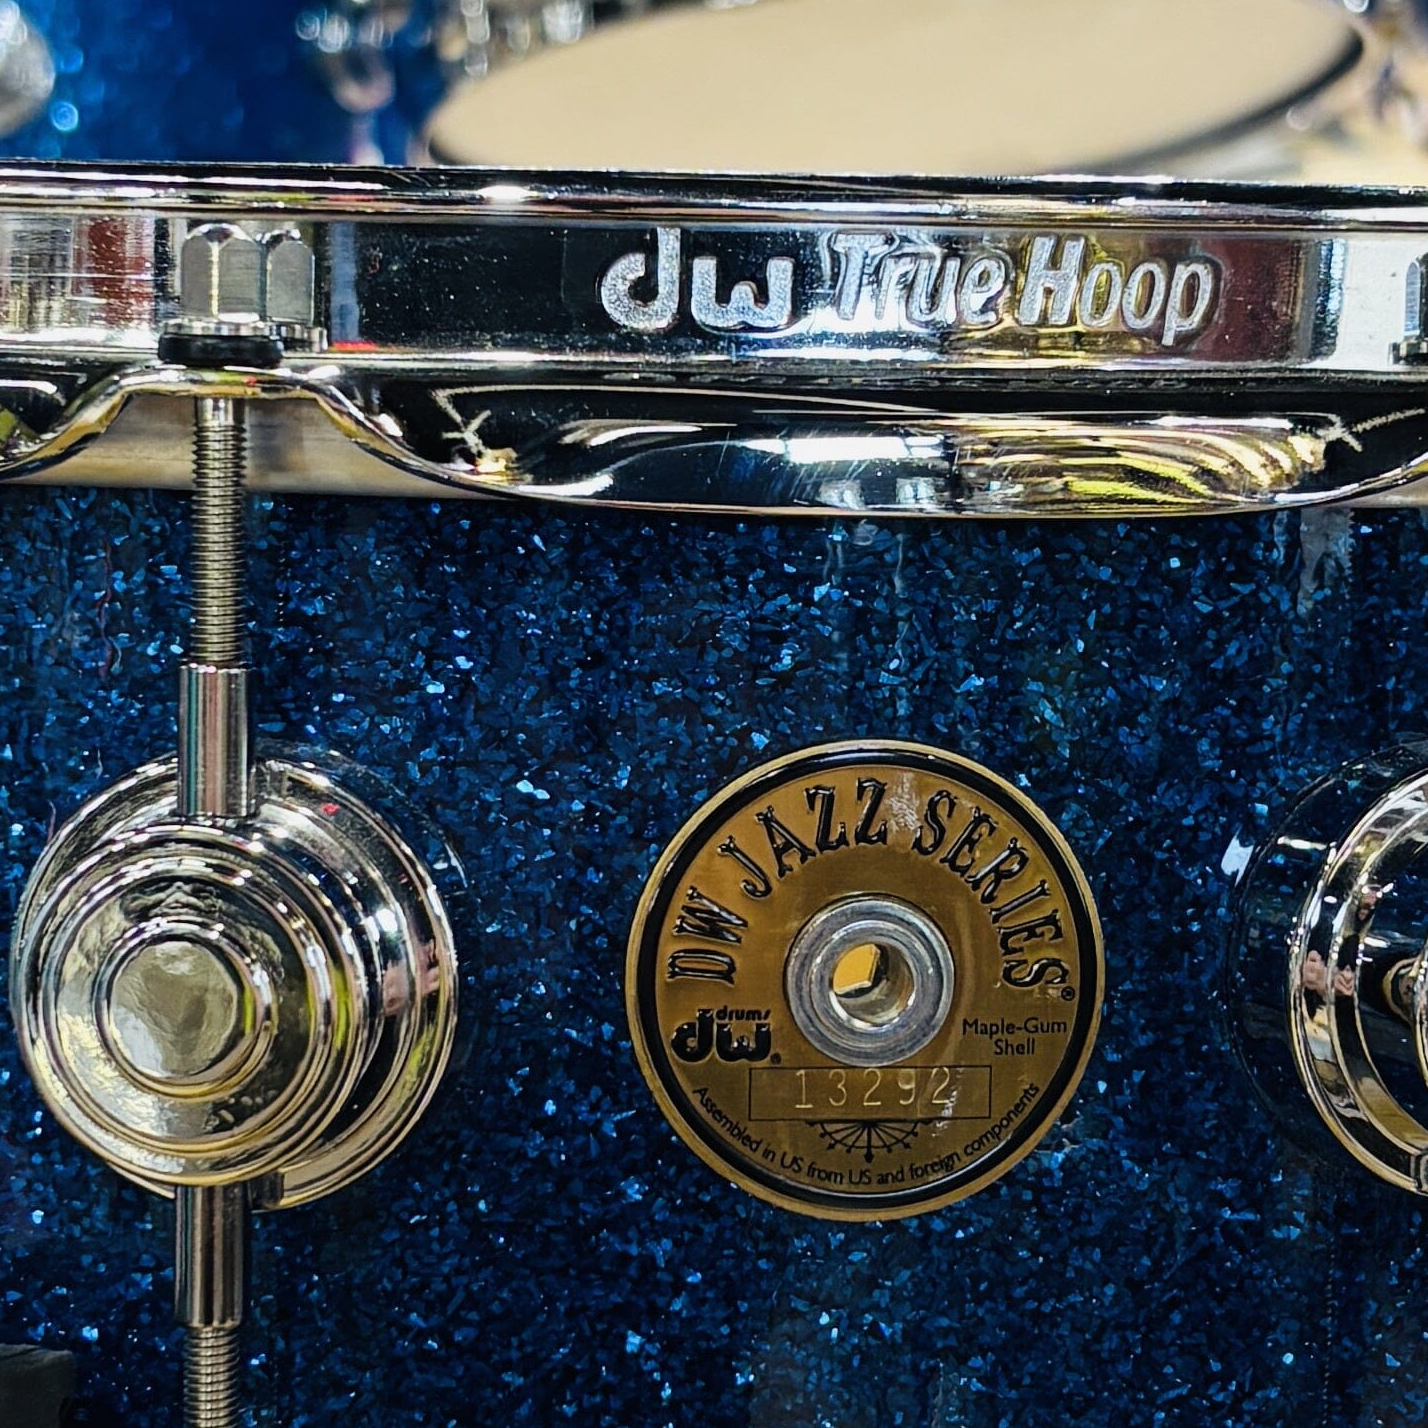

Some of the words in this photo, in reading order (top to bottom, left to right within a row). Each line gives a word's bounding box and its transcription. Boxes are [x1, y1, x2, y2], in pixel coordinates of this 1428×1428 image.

[600, 226, 795, 331] dw
[830, 230, 1010, 327] True
[1014, 234, 1215, 346] Hoop
[666, 885, 748, 986] DW
[717, 777, 888, 899] JAZZ
[911, 789, 1071, 989] SERIES
[671, 1008, 772, 1063] dw
[961, 1016, 1068, 1040] Maple-Gum
[993, 1036, 1037, 1056] Shell
[795, 1067, 951, 1109] 13292
[692, 1087, 763, 1153] Assembled
[762, 1146, 776, 1163] in
[779, 1151, 805, 1173] US
[807, 1162, 843, 1185] from
[848, 1169, 873, 1186] US
[876, 1165, 905, 1186] and
[909, 1149, 962, 1181] foreign
[962, 1082, 1041, 1156] components
